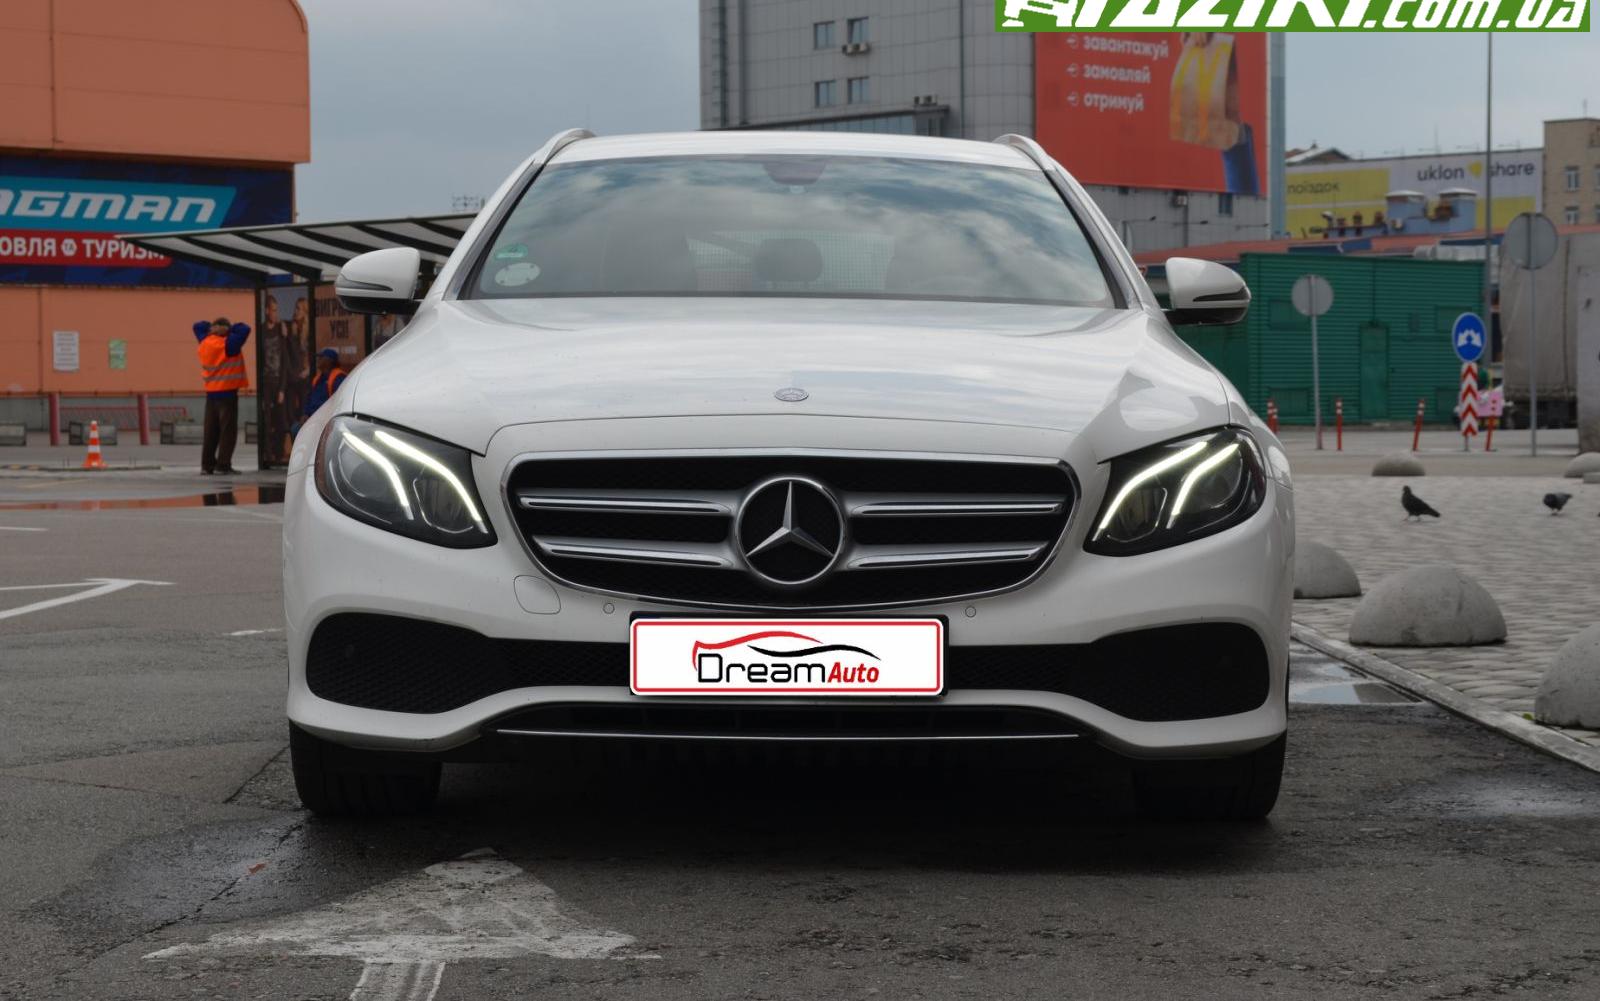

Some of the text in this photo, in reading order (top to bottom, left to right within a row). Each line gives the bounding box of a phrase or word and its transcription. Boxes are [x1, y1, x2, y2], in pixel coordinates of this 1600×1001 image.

[1083, 35, 1168, 60] завантажуй
[1083, 64, 1152, 84] замовляй
[1083, 92, 1145, 114] отримуй
[1417, 164, 1465, 182] uklon
[0, 189, 216, 223] GMAN
